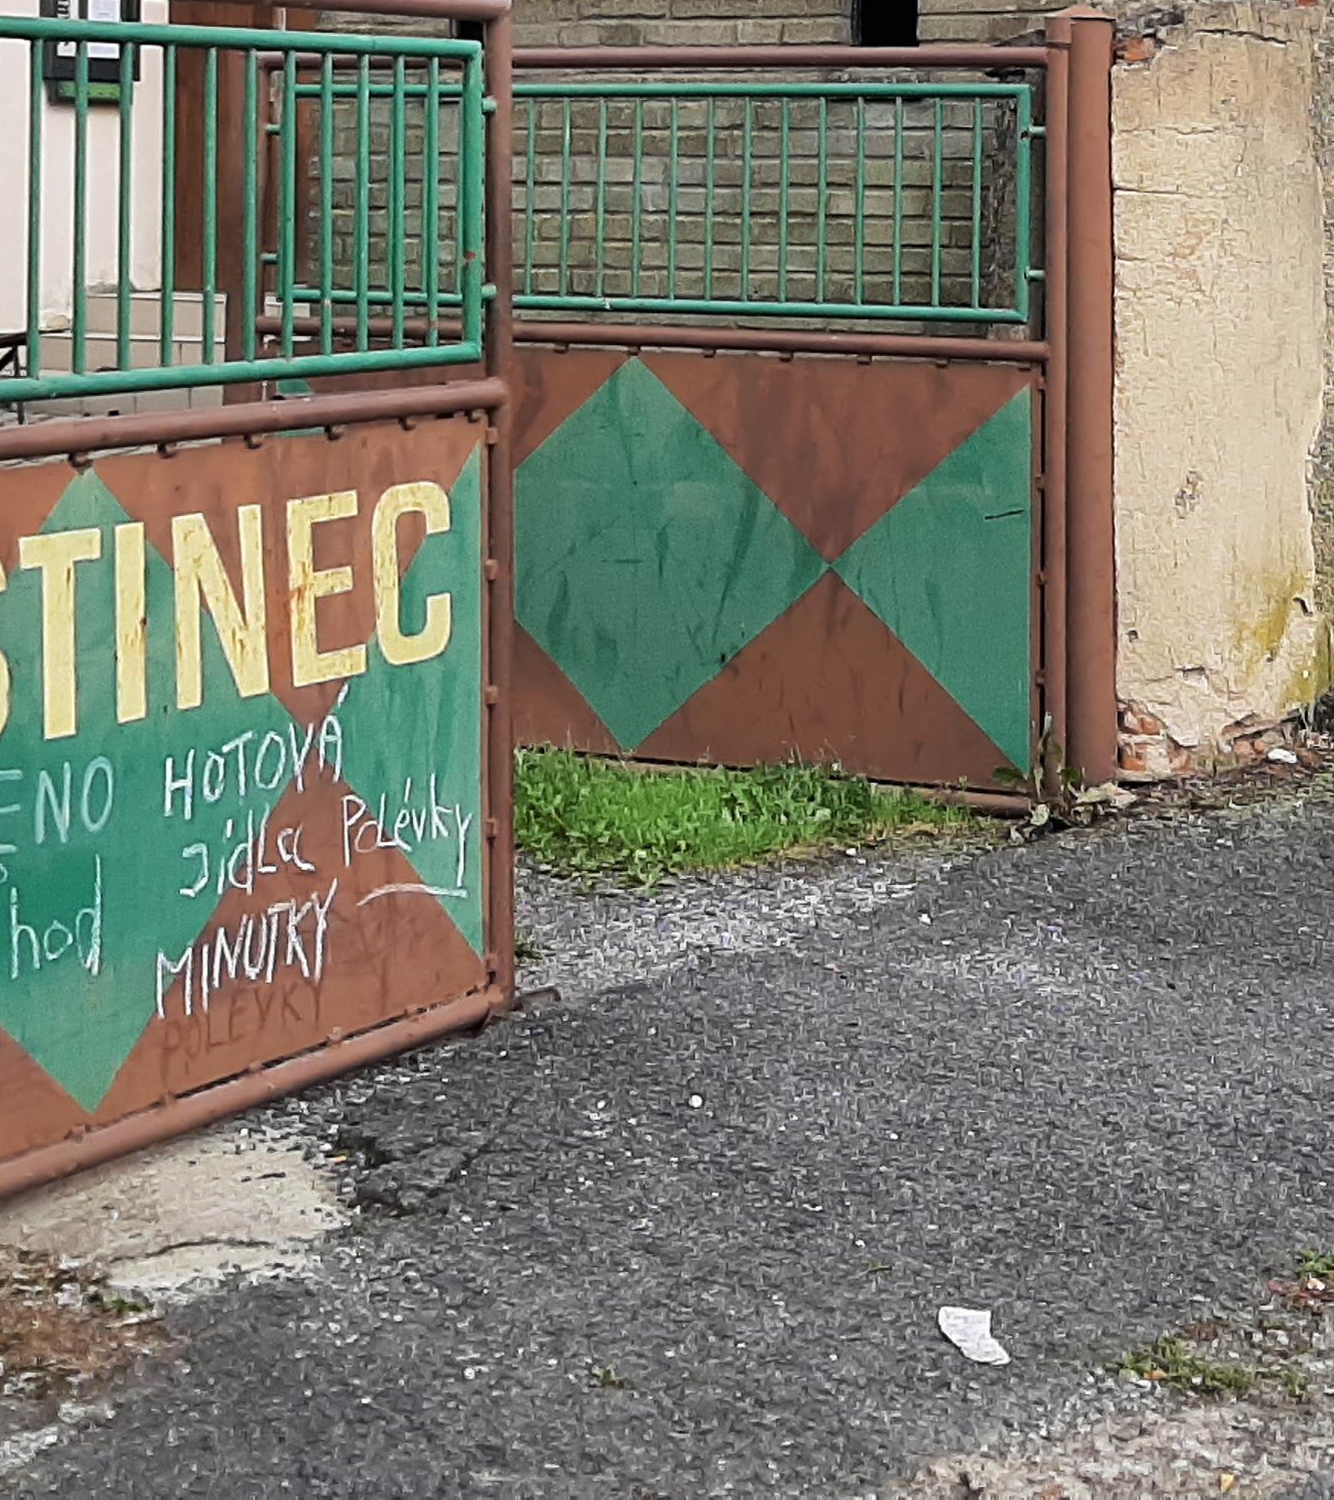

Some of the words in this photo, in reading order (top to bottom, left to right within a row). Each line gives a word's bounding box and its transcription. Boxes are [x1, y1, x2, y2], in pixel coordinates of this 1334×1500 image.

[164, 682, 350, 820] HOTOVÁ
[10, 854, 102, 980] hod
[155, 878, 339, 1020] MINUTKY
